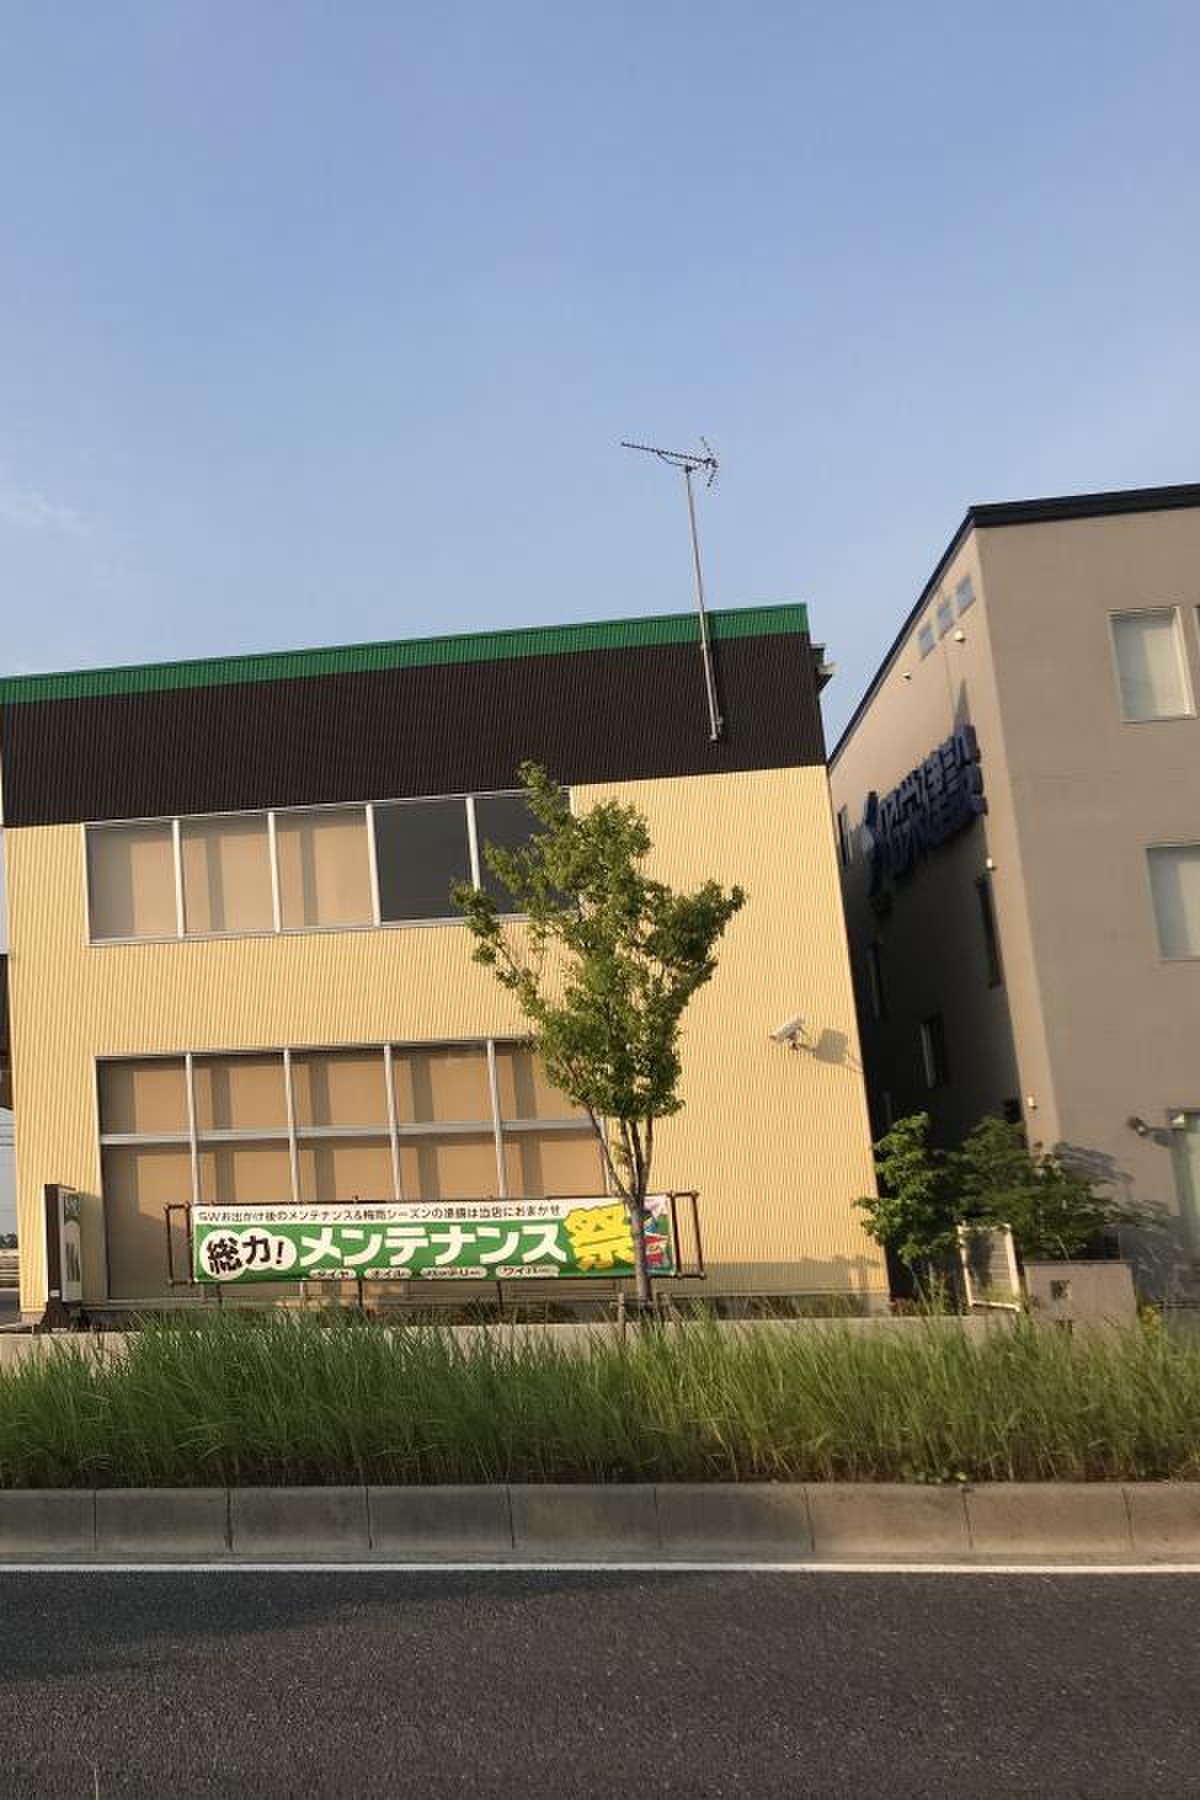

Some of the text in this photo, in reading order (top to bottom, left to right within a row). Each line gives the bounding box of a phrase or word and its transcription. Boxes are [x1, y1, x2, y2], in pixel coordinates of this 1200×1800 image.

[299, 1224, 568, 1266] メンテナンス
